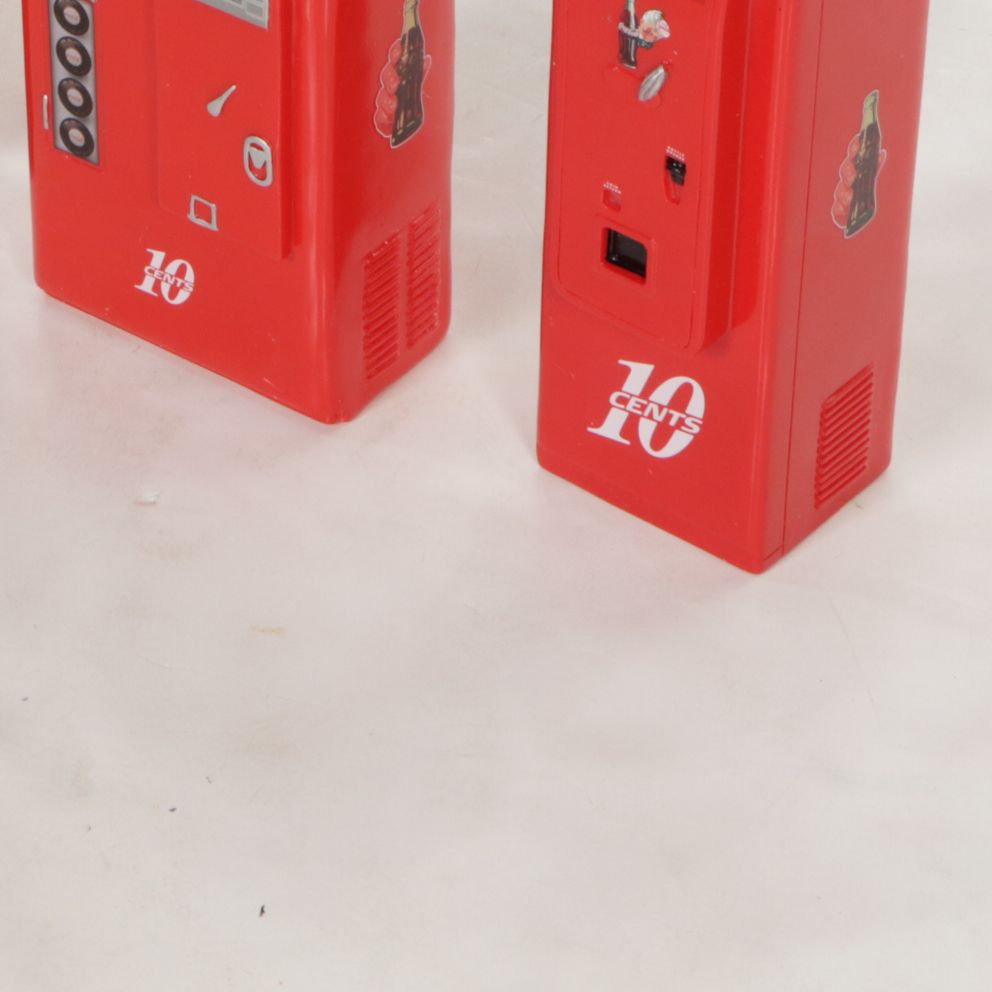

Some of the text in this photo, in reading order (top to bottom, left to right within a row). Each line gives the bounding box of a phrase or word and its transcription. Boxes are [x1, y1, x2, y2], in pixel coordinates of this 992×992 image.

[133, 248, 195, 305] 10
[144, 265, 195, 294] CENTS
[586, 358, 706, 459] 10
[609, 390, 704, 435] CENTS
